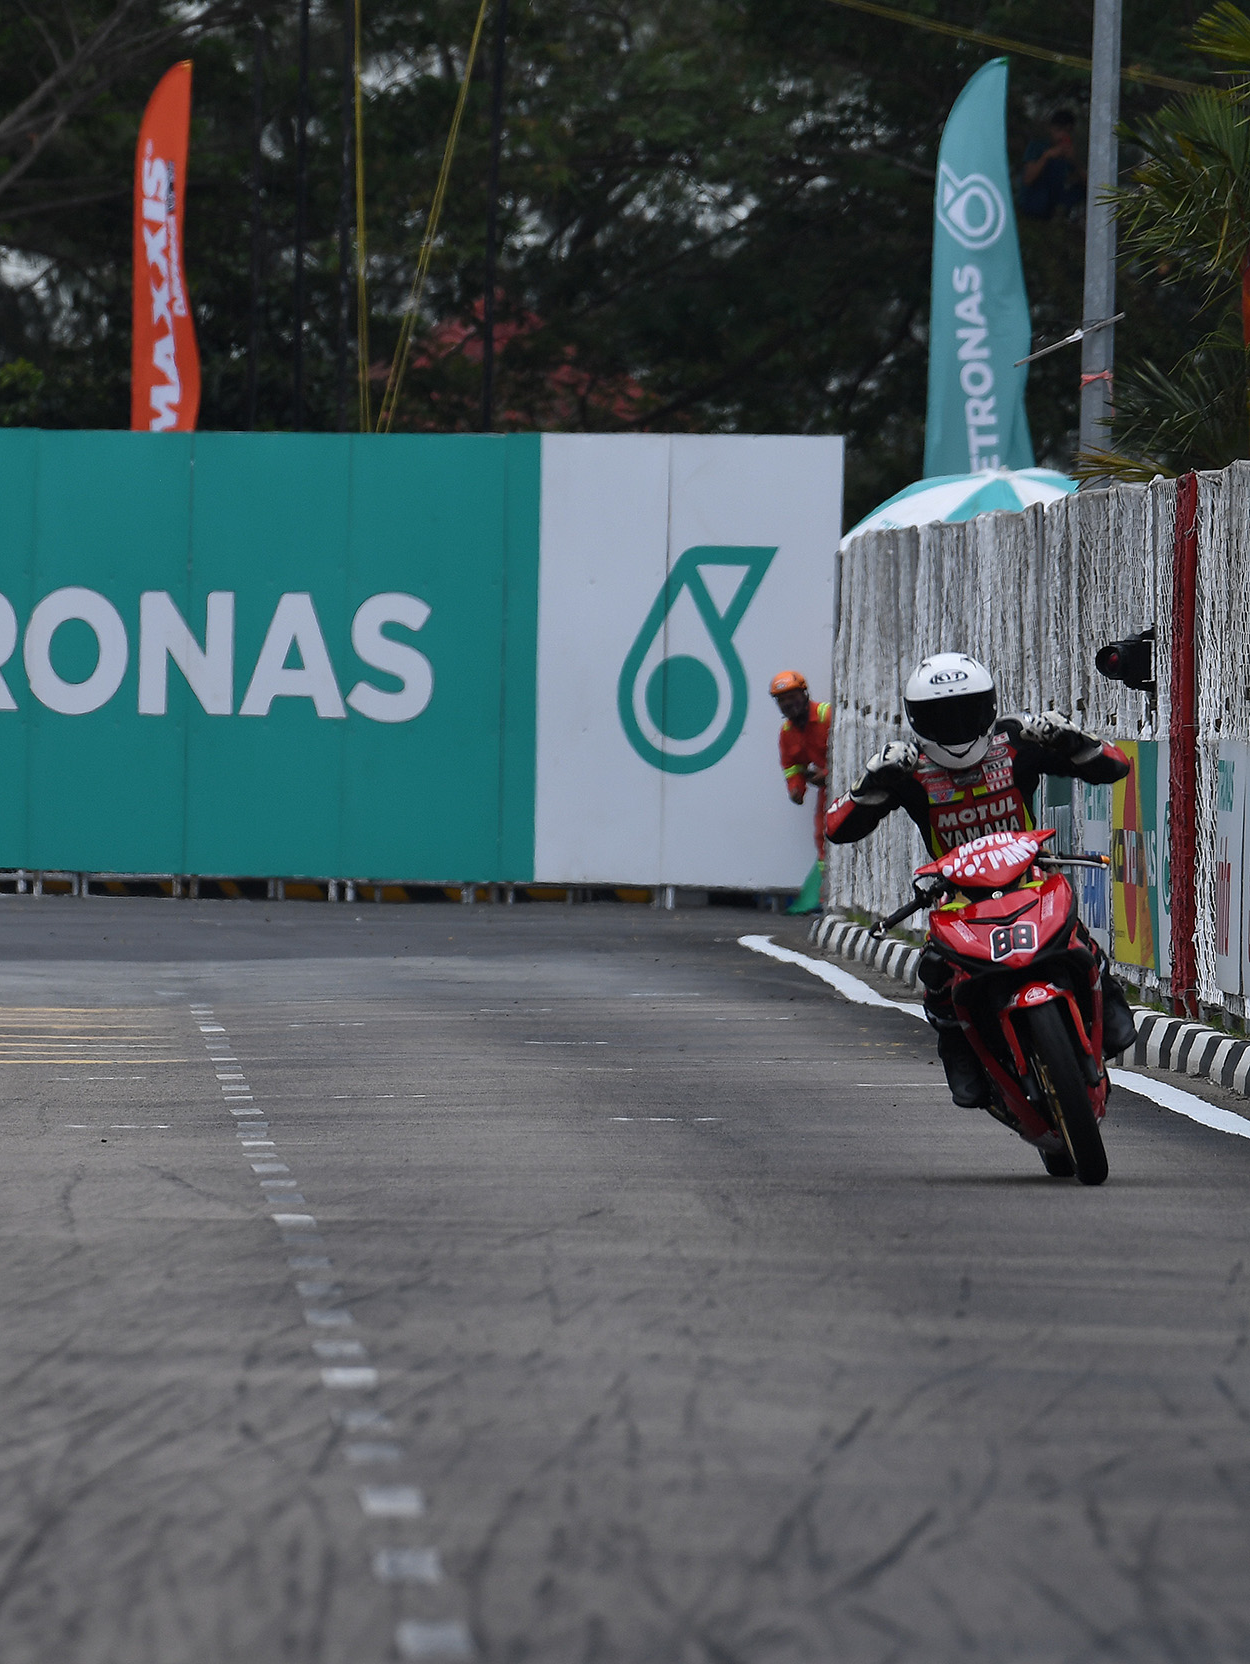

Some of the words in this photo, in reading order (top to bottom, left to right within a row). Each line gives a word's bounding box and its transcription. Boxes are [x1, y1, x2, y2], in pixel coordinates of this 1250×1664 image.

[933, 670, 965, 684] KYT
[938, 795, 1018, 829] MOTUL
[940, 815, 1020, 850] YAMAHA
[958, 832, 1017, 859] MOTUL
